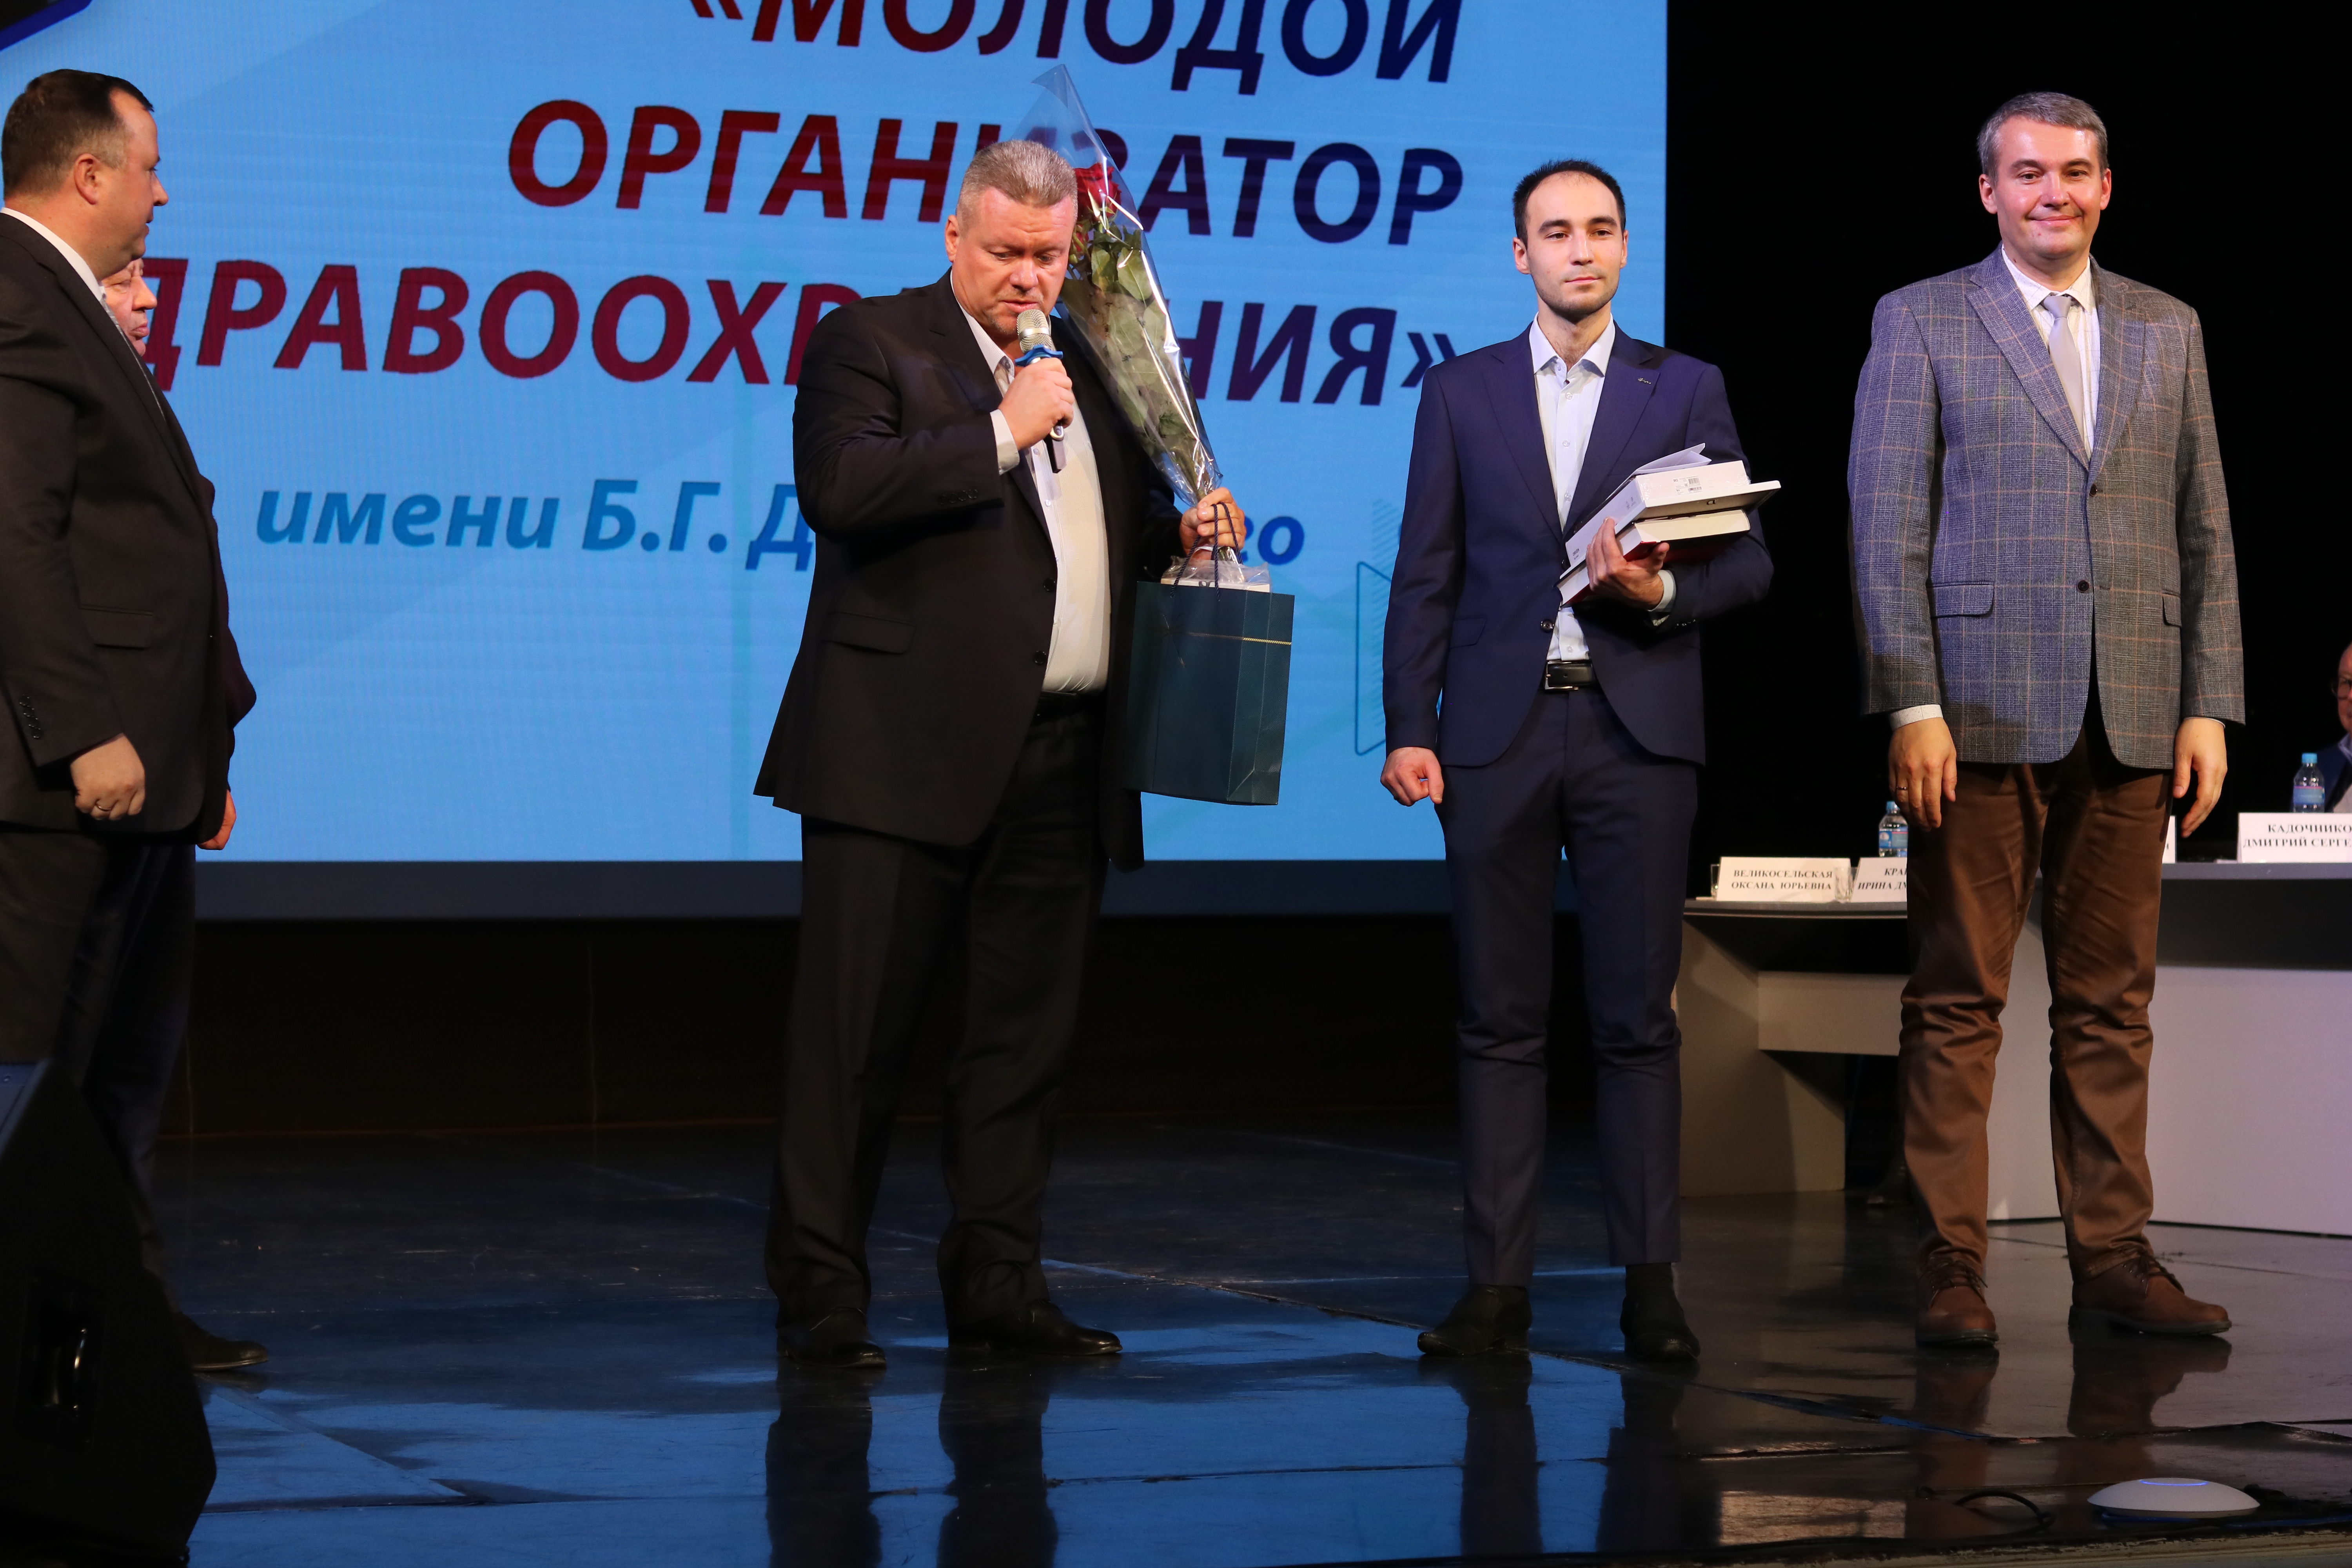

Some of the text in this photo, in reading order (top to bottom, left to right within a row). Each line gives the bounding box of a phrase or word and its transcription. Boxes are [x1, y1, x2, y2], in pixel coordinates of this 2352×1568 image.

[509, 99, 1463, 245] ОРГАНАТОР
[256, 491, 560, 550] имени
[582, 479, 728, 554] Б.Г.
[2243, 837, 2307, 848] ДМИТРИЙ
[1858, 882, 1892, 890] ИРИНА
